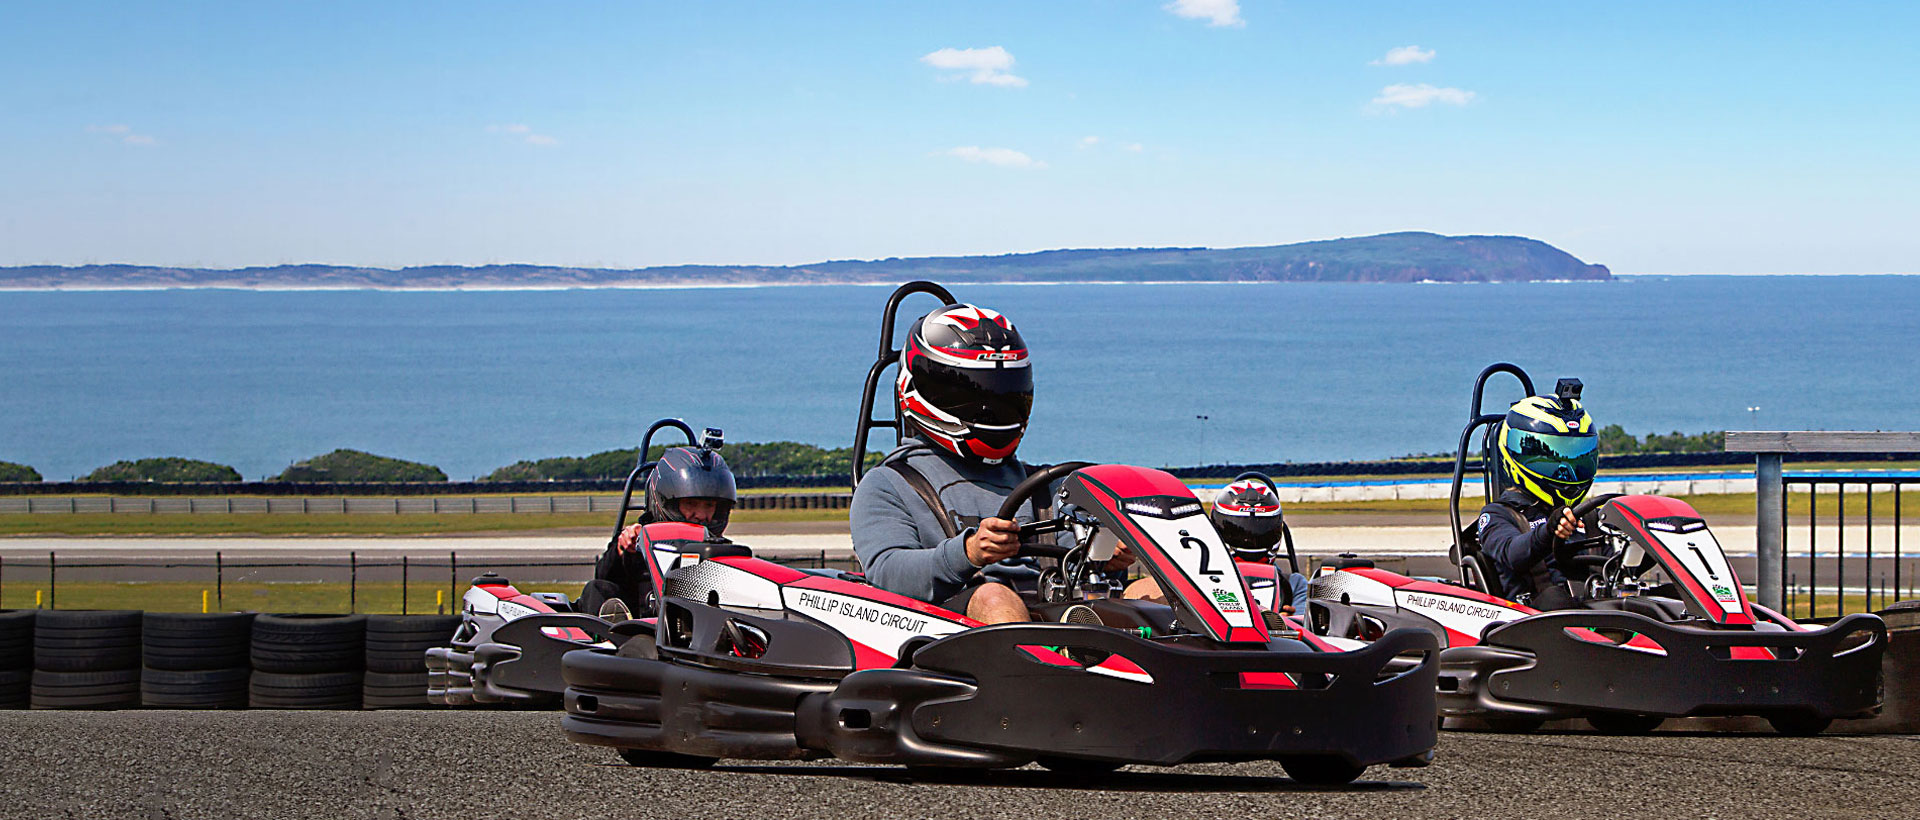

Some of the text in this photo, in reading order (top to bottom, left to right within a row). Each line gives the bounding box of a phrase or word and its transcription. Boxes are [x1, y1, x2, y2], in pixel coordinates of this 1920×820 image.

[1180, 537, 1224, 575] 2
[1688, 547, 1715, 575] 1
[799, 592, 928, 634] PHILLIP ISLAND CIRCUIT
[1407, 594, 1502, 620] PHILLIP ISLAND CIRCUIT
